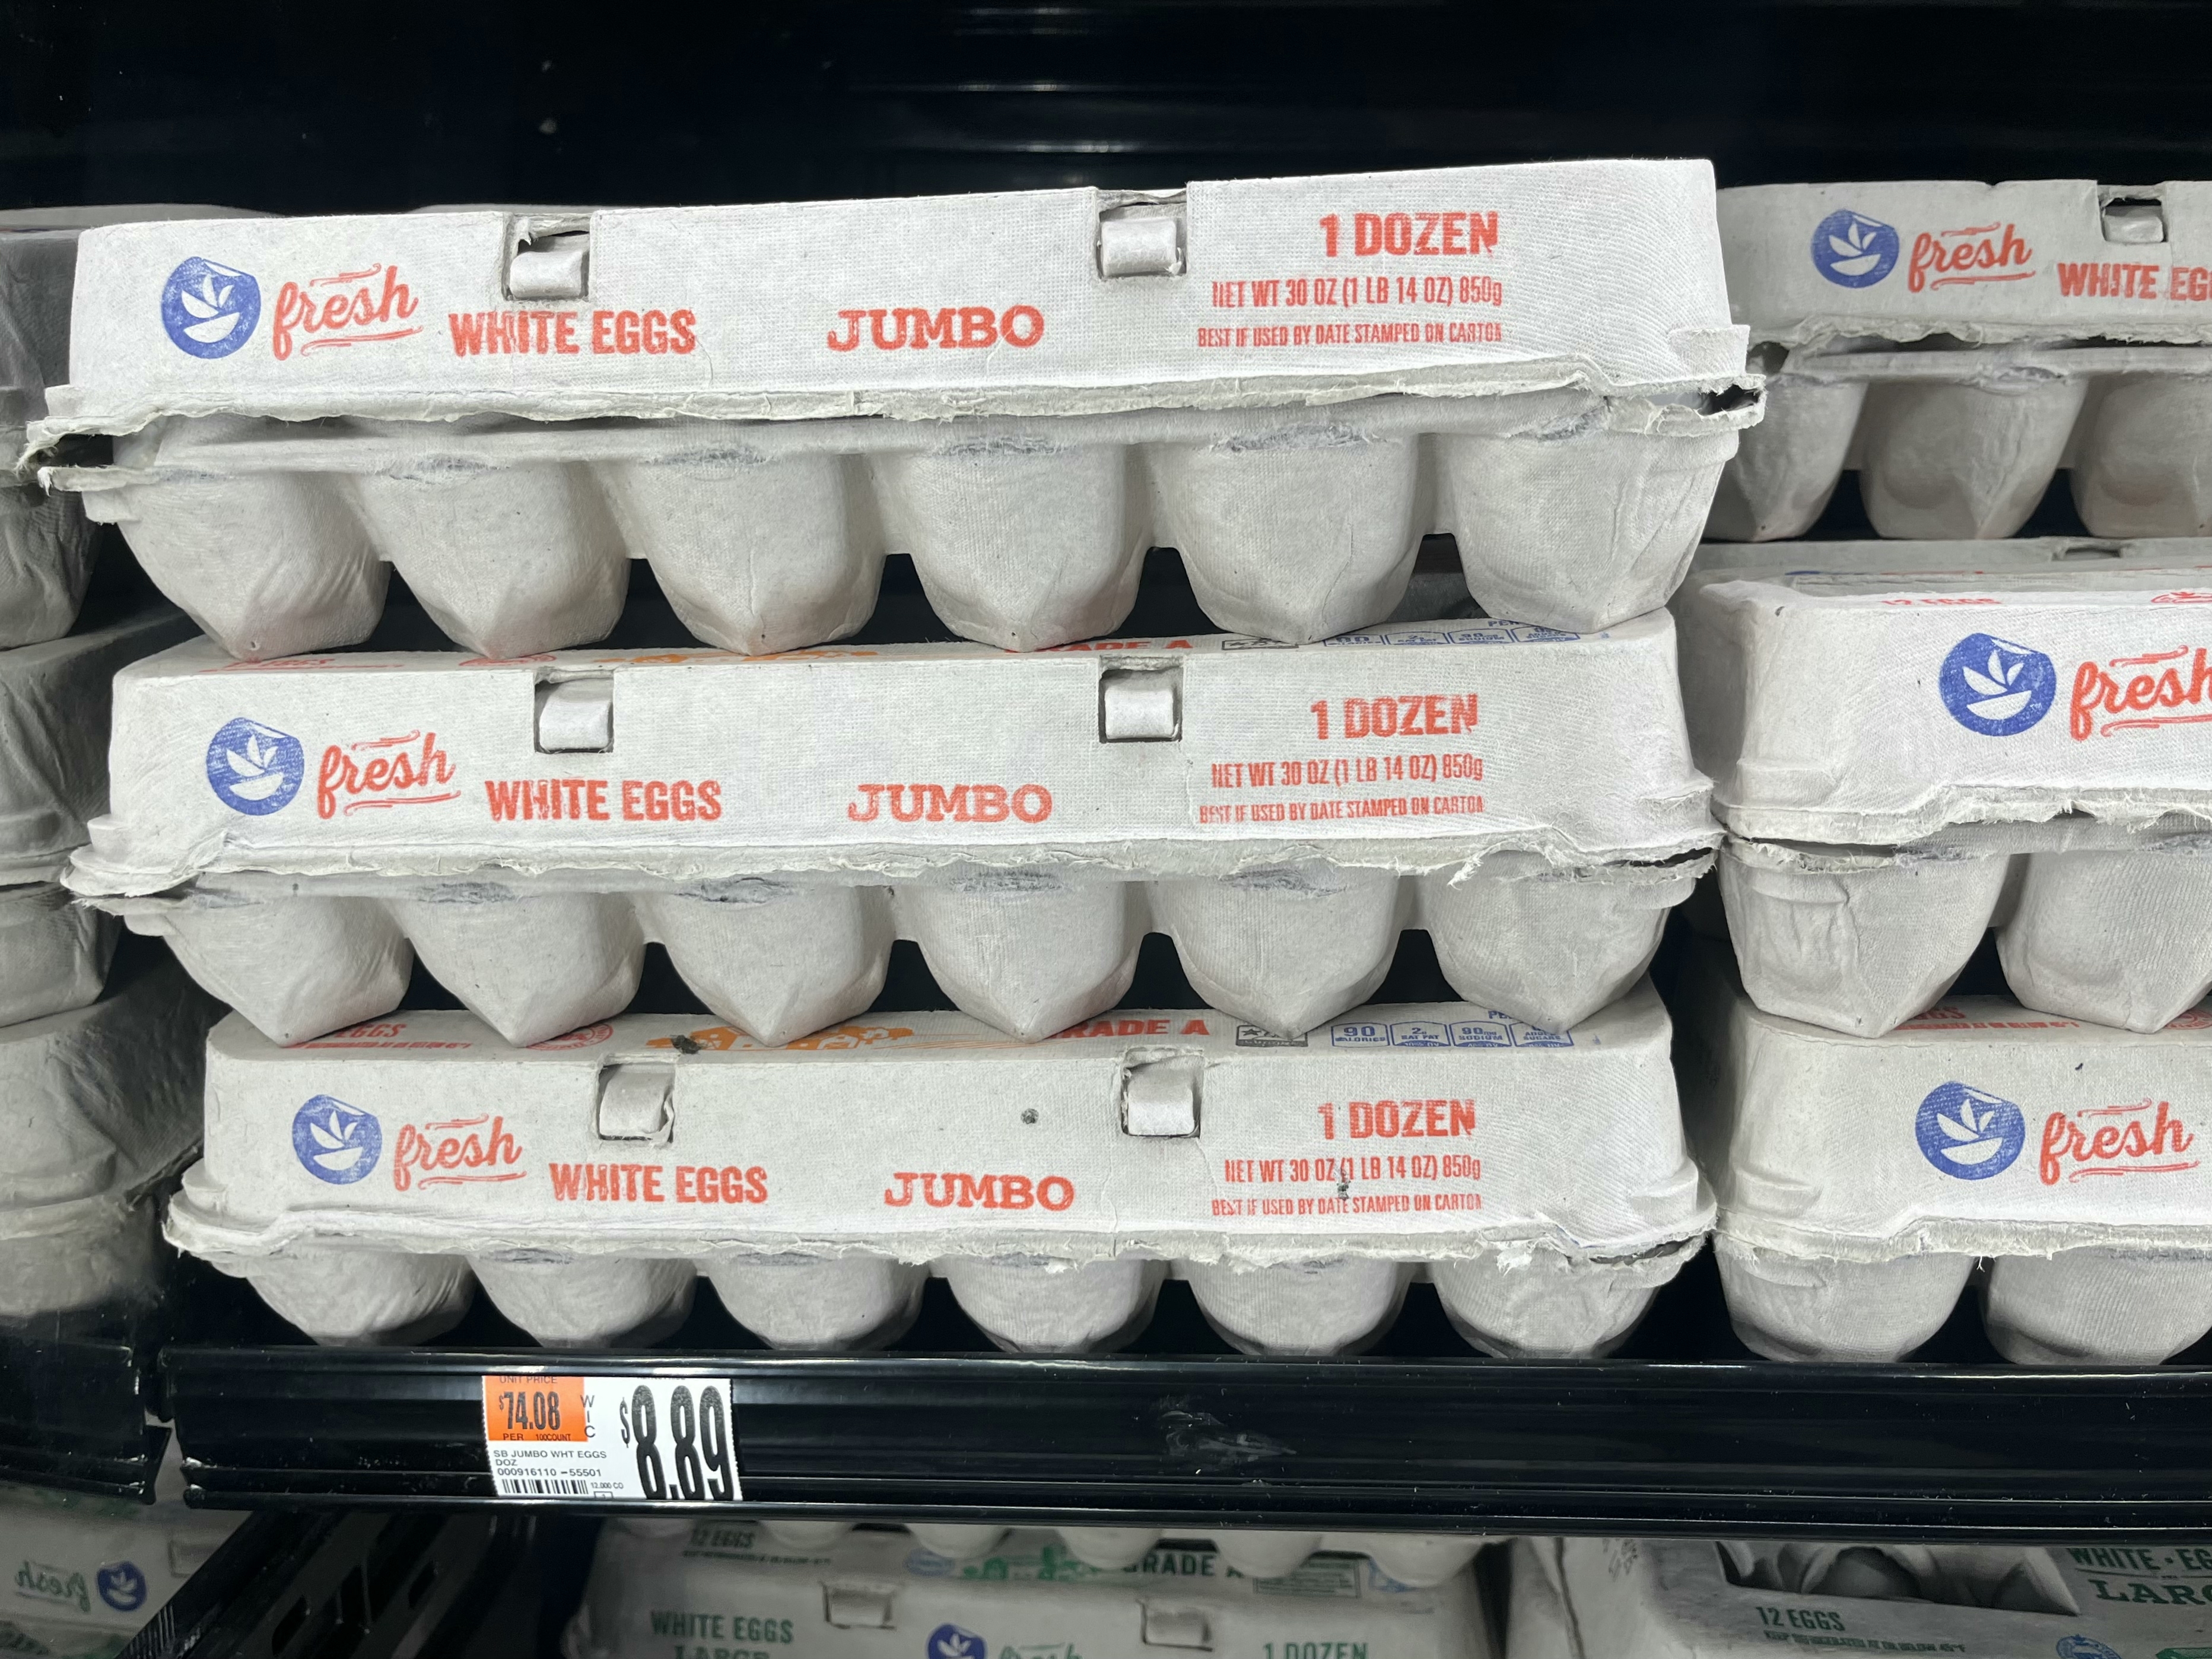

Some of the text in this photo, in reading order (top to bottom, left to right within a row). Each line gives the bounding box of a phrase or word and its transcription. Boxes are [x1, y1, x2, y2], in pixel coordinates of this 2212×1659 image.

[1320, 211, 1499, 258] 1 DOZEN
[1908, 224, 2032, 293] fresh
[1213, 276, 1502, 308] NET WT 30 OZ (1 LB 14 OZ) 850g
[2058, 262, 2212, 301] WHITE EG
[273, 265, 419, 361] fresh
[827, 304, 1044, 352] JUMBO
[449, 309, 697, 357] WHITE EGGS
[1198, 323, 1502, 347] BEST IF USED BY DATE STAMPED ON CARTON
[1166, 640, 1193, 649] A
[1311, 694, 1478, 740] 1 DOZEN
[317, 733, 455, 819] fresh
[1212, 754, 1483, 788] NET WT 30 OZ (1 LB 14 OZ) 850g
[485, 778, 722, 822] WHITE EGGS
[848, 783, 1053, 824] JUMBO
[1200, 796, 1484, 824] BEST IF USED BY DATE STAMPED ON CARTON
[1053, 1019, 1209, 1038] RADE A
[1343, 1026, 1375, 1037] 90
[1488, 1010, 1514, 1019] PE
[1318, 1099, 1476, 1140] 1 DOZEN
[393, 1116, 523, 1191] fresh
[2040, 1101, 2194, 1186] fresh
[549, 1163, 768, 1204] WHITE EGGS
[1225, 1159, 1254, 1183] NET
[1259, 1159, 1285, 1183] WT
[1289, 1159, 1310, 1182] 30
[1314, 1158, 1336, 1181] OZ
[1361, 1156, 1381, 1180] LB
[1387, 1155, 1406, 1178] 14
[1411, 1155, 1438, 1181] OZ)
[1442, 1155, 1481, 1180] 850g
[884, 1172, 1075, 1212] JUMBO
[1212, 1194, 1481, 1216] BEST IF USED BY DATE STAMPED ON CARTON
[498, 1391, 561, 1430] $74.08
[494, 1450, 508, 1458] SB
[535, 1433, 571, 1441] 100COUNT
[619, 1384, 734, 1500] $8.89
[497, 1467, 557, 1476] 000916110
[1124, 1550, 1216, 1577] RADE
[2068, 1547, 2162, 1571] WHITE
[651, 1610, 794, 1645] WHITE EGGS
[1756, 1606, 1846, 1632] 12 EGGS
